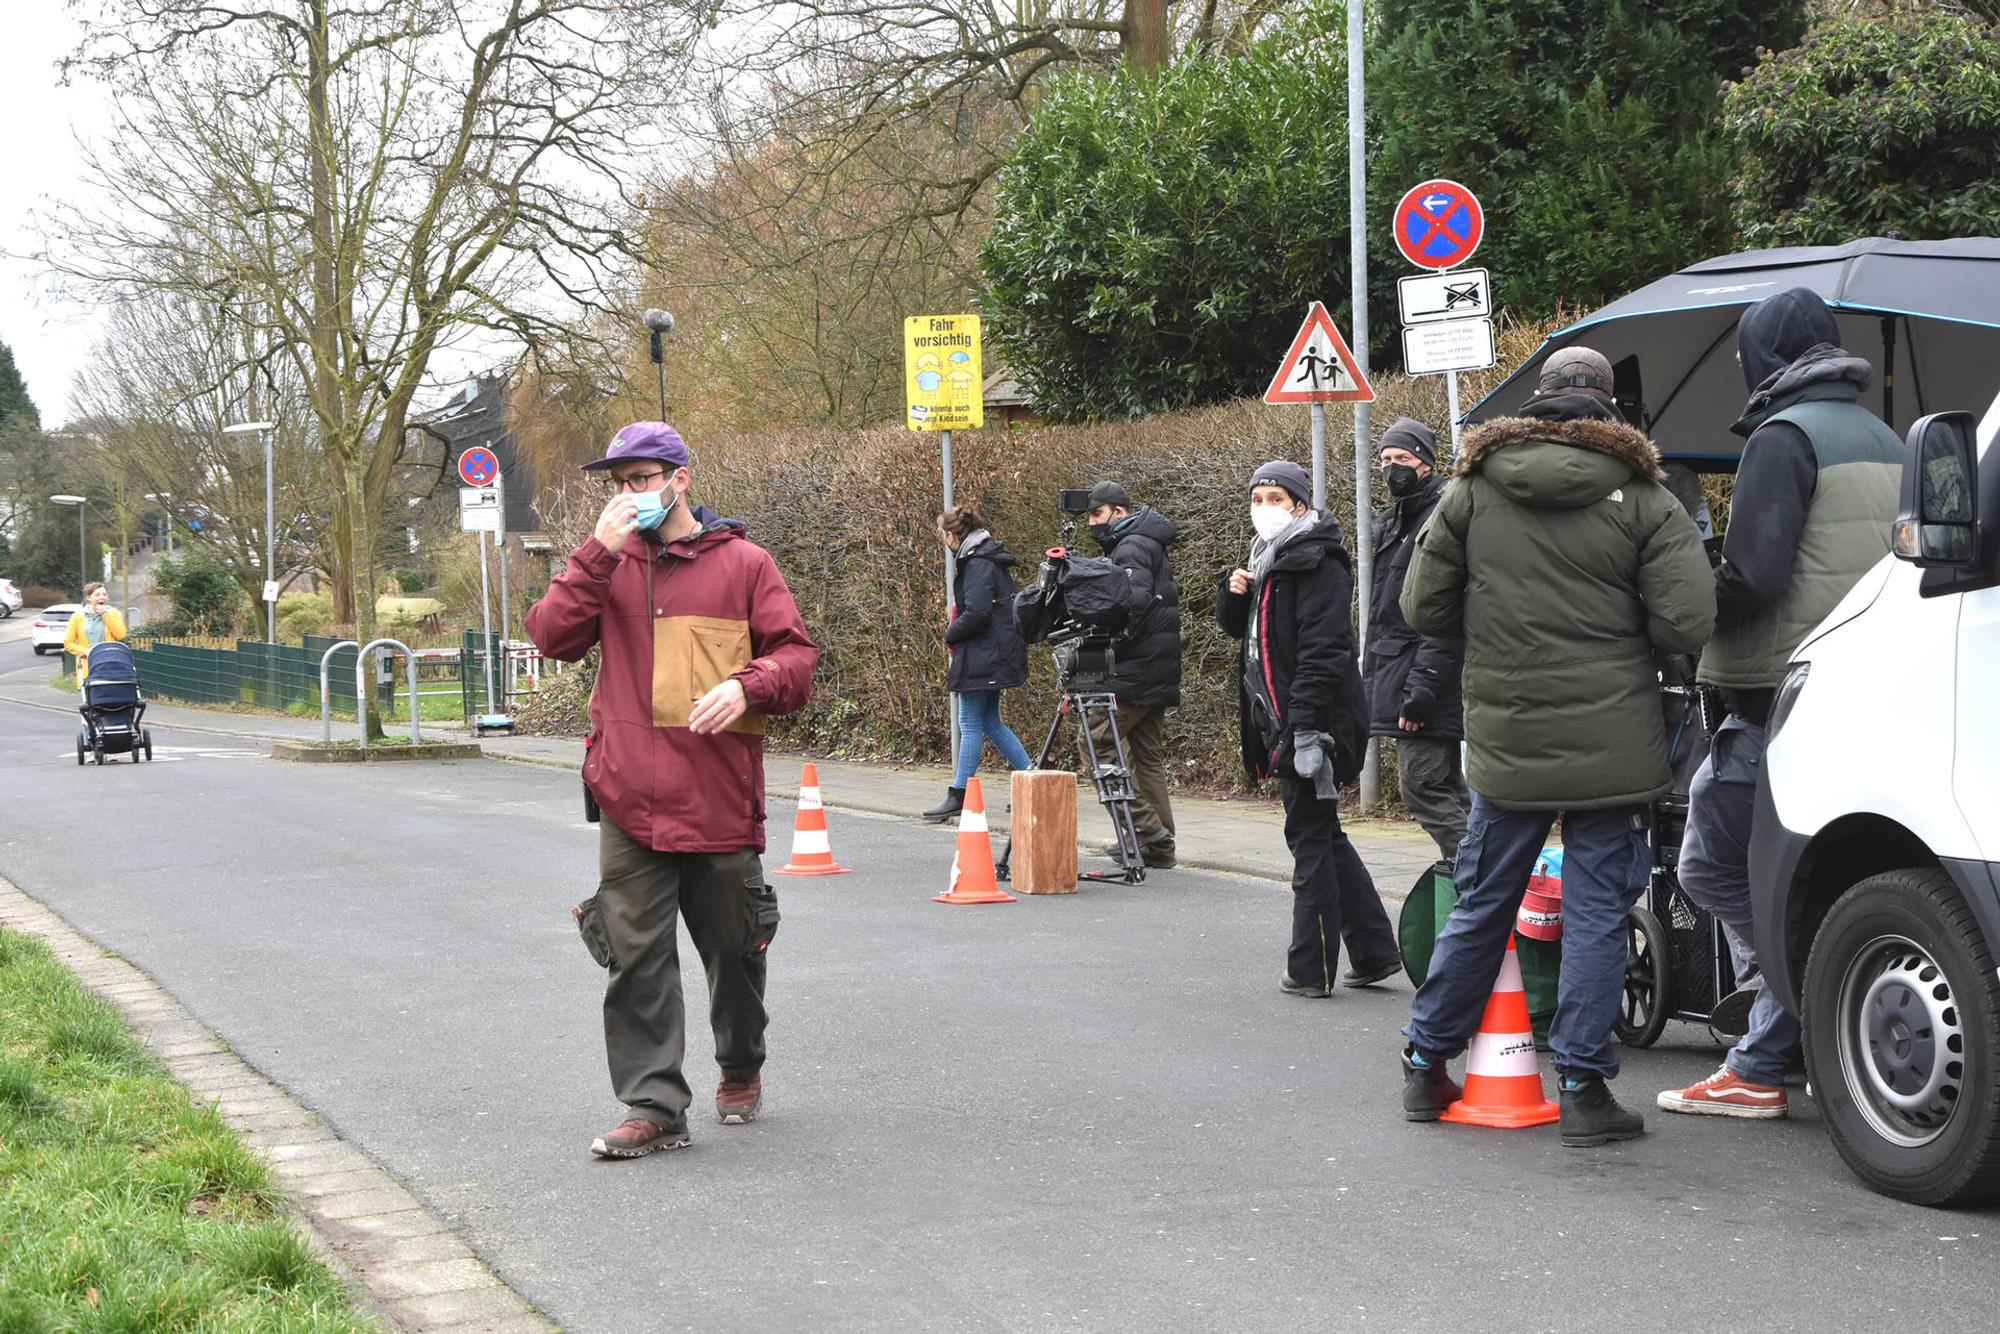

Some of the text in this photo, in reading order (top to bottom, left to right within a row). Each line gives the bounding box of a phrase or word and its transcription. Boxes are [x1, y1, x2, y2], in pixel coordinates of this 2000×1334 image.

[929, 318, 955, 331] Fahr
[914, 333, 972, 347] vorsichtig
[930, 404, 970, 412] könnte auch
